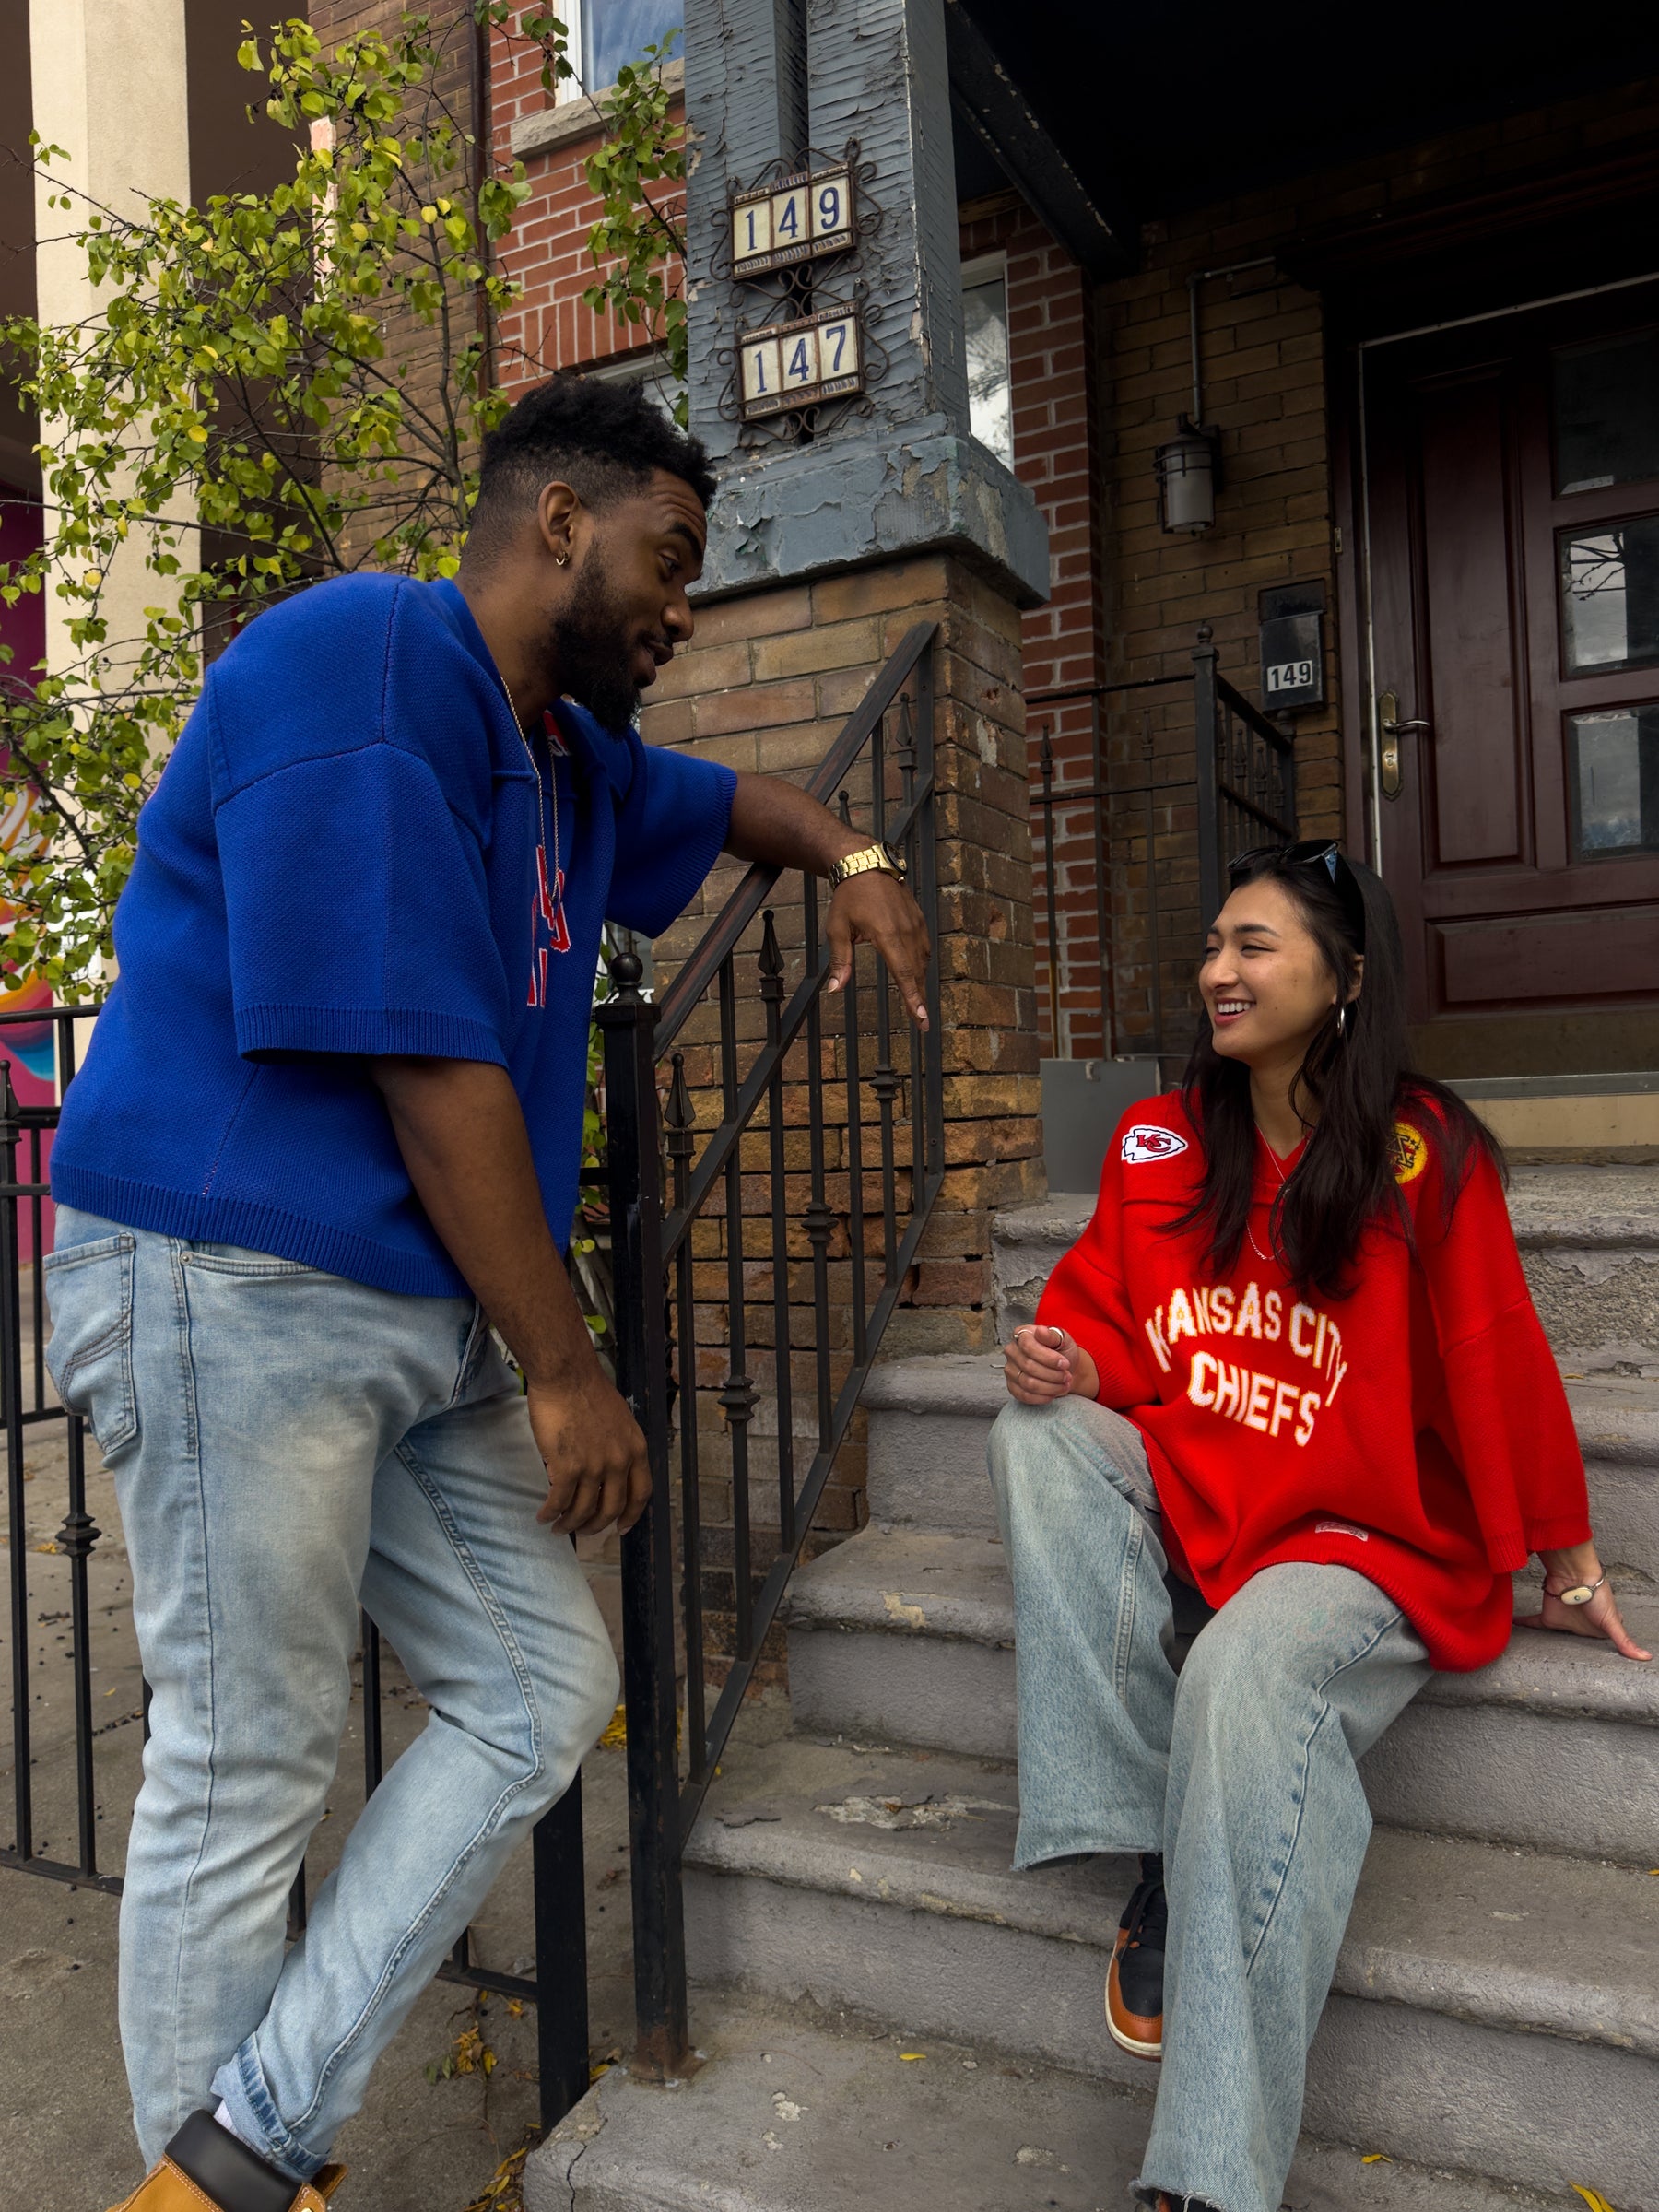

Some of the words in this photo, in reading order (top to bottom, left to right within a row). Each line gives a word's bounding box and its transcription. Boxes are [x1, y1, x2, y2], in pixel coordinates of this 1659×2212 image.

[745, 186, 840, 252] 149
[755, 324, 846, 394] 147
[1271, 662, 1311, 689] 149
[1136, 1134, 1171, 1153] KC
[1145, 1281, 1283, 1373] KANSAS
[1288, 1301, 1348, 1407] CITY
[1186, 1350, 1321, 1447] CHIEFS
